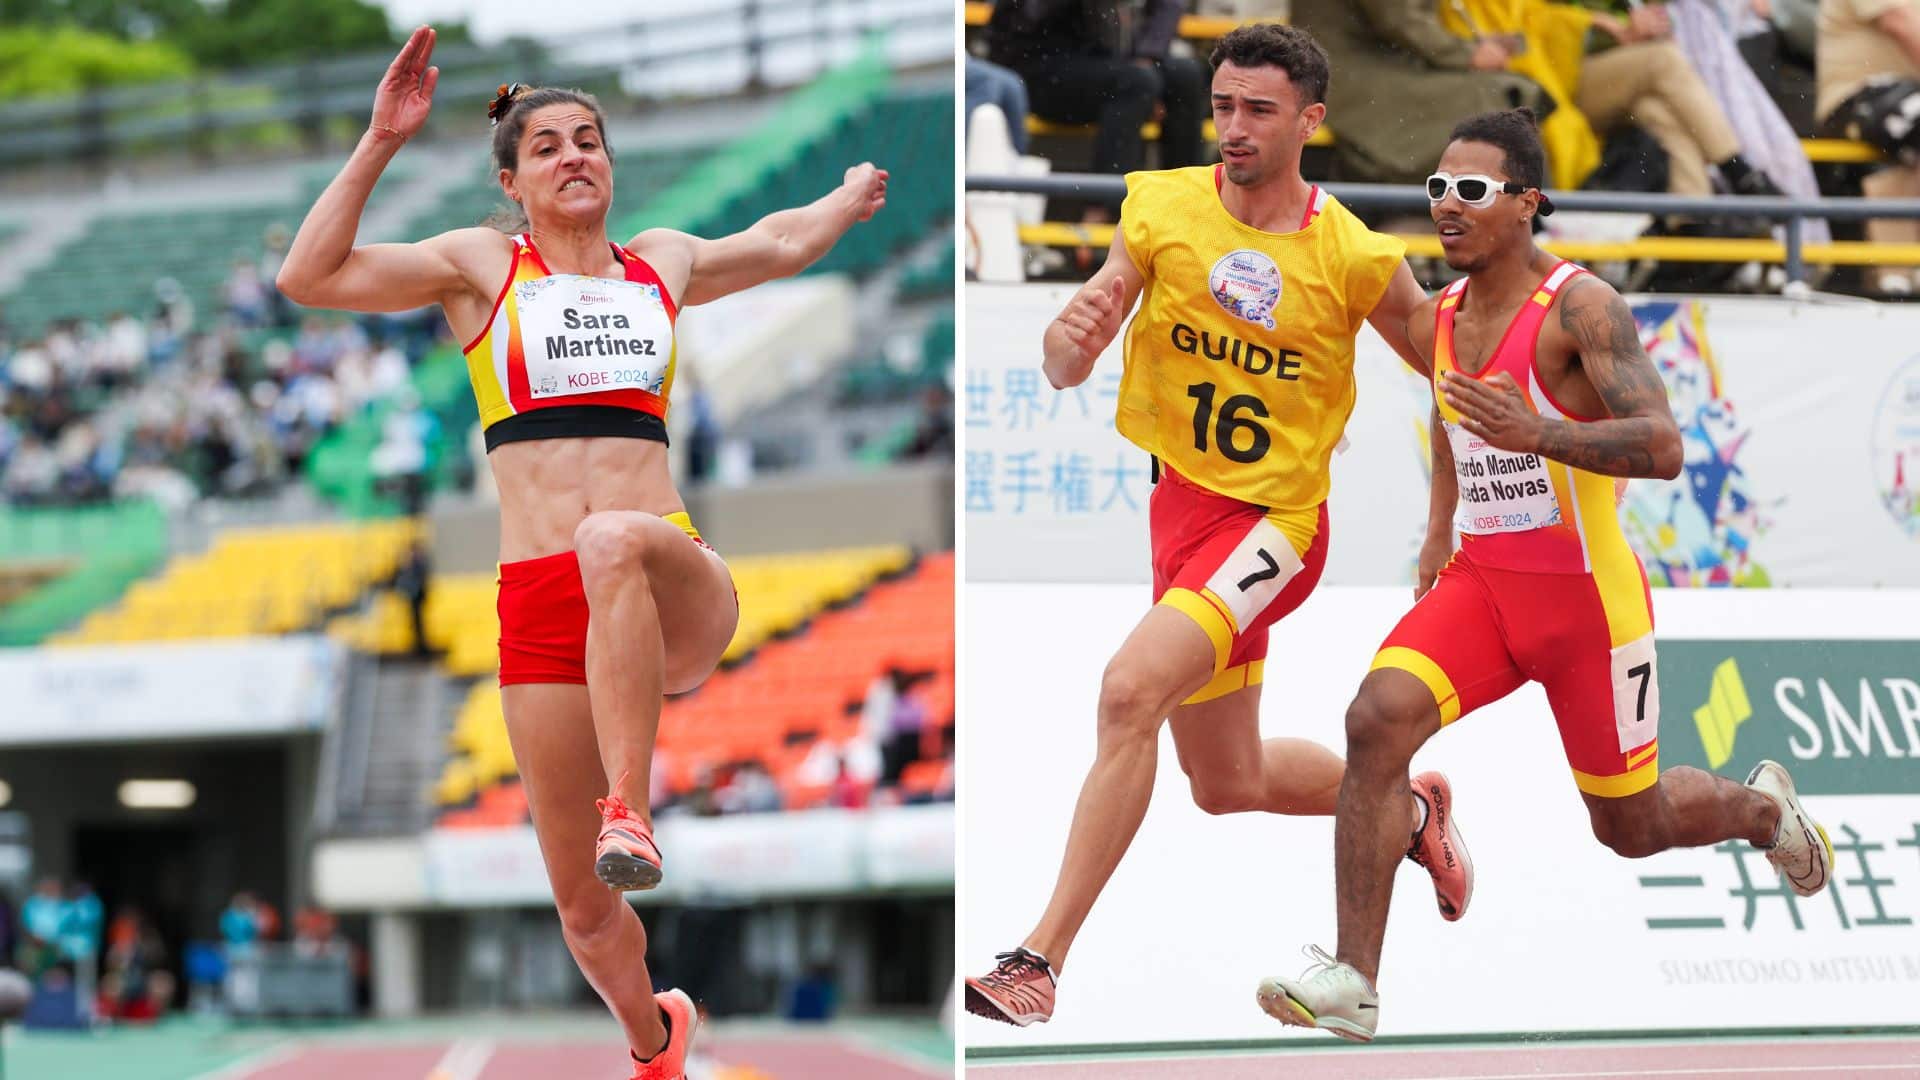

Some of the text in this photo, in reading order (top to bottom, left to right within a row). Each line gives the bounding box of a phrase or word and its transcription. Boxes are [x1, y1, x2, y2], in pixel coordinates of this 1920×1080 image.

[563, 307, 630, 330] Sara
[545, 334, 657, 360] Martinez
[1171, 323, 1303, 381] GUIDE
[568, 369, 649, 388] KOBE 2024
[1187, 381, 1271, 464] 16
[1486, 453, 1542, 478] Manuel
[1490, 477, 1549, 502] Novas
[1502, 512, 1532, 527] 2024
[1236, 547, 1281, 593] 7
[1627, 661, 1651, 723] 7
[1430, 785, 1456, 869] new balance
[1638, 820, 1920, 933] 三井住
[1659, 959, 1802, 985] SUMITOMO
[1808, 956, 1897, 983] MITSUI
